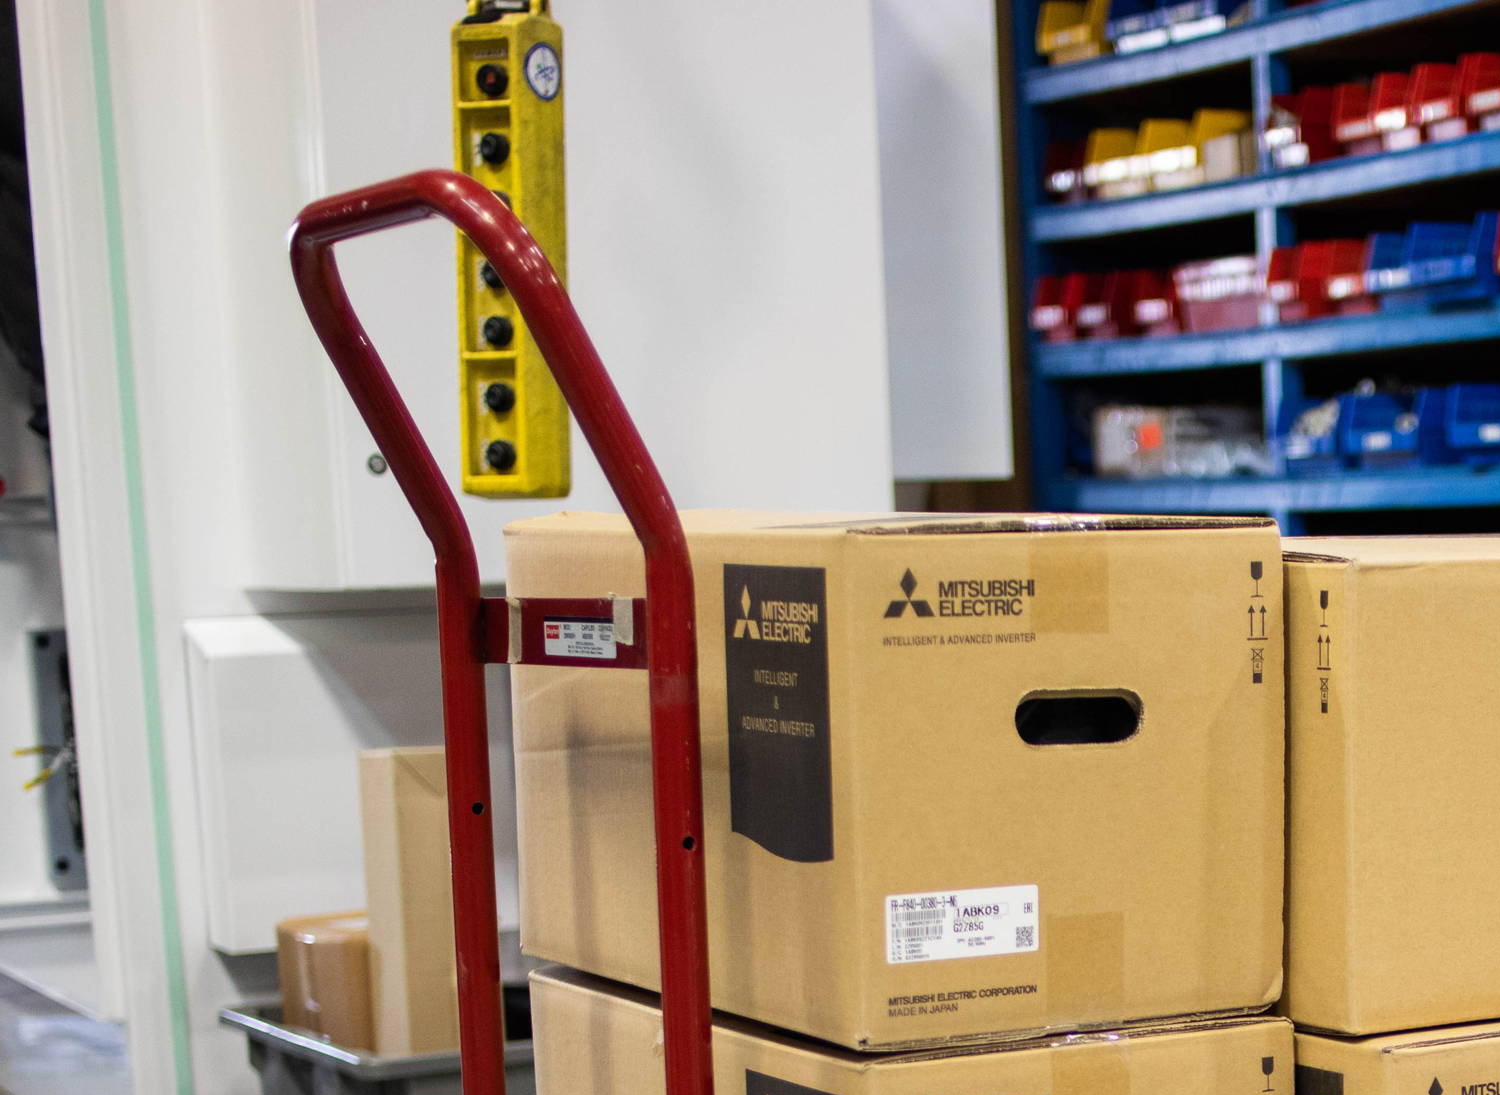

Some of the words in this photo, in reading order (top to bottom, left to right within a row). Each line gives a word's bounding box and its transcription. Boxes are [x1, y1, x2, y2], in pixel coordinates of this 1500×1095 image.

[938, 579, 1035, 598] MITSUBISHI
[761, 600, 818, 623] MITSUBISHI
[939, 598, 1023, 617] ELECTRIC
[762, 621, 811, 644] ELECTRIC
[883, 634, 937, 646] INTELLIGENT
[940, 635, 945, 645] &
[948, 634, 993, 645] ADVANCED
[995, 632, 1036, 644] INVERTER
[754, 669, 798, 687] INTELLIGENT
[774, 696, 780, 710] &
[742, 715, 777, 734] ADVANCED
[780, 719, 815, 738] INVERTER
[957, 905, 1000, 918] 1ABK09
[889, 995, 936, 1007] MITSUBISHI
[938, 990, 977, 1002] ELECTRIC
[979, 984, 1038, 998] CORPORATION
[889, 1005, 917, 1017] MADE
[919, 1005, 927, 1014] IN
[930, 1003, 958, 1014] JAPAN
